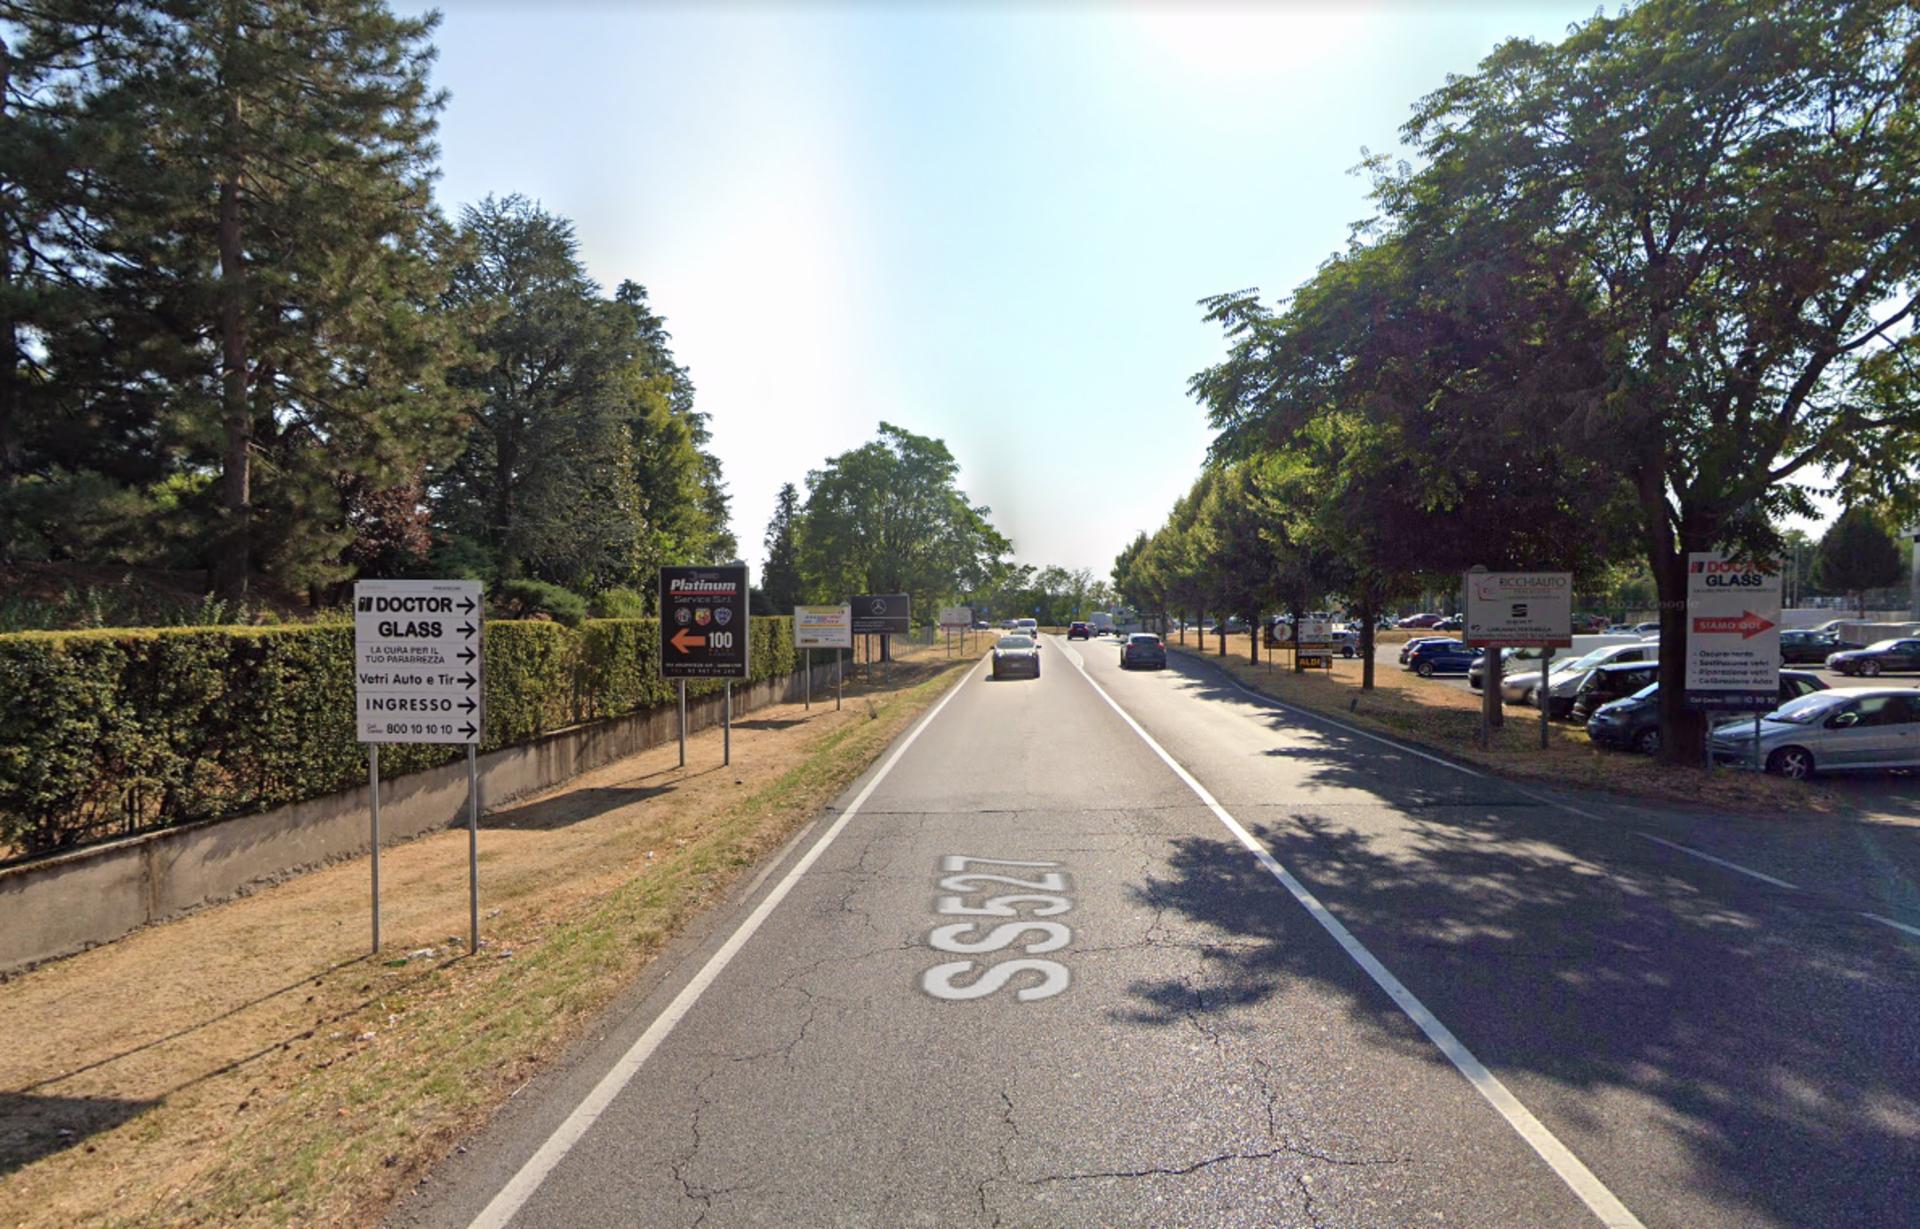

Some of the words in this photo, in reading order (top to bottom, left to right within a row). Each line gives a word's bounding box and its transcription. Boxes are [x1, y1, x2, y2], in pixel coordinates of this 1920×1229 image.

[1707, 560, 1783, 573] DOC
[670, 578, 736, 590] Platinum
[1500, 577, 1566, 587] RICCHIAUTO
[1706, 574, 1762, 587] GLASS
[376, 597, 452, 612] DOCTOR
[378, 621, 443, 637] GLASS
[1699, 622, 1736, 630] SIAMO
[709, 632, 732, 648] 100
[370, 646, 382, 654] LA
[384, 646, 408, 654] CURA
[411, 646, 429, 654] PER
[430, 646, 439, 654] IL
[365, 655, 384, 663] TUO
[387, 656, 445, 664] PARABREZZA
[359, 673, 388, 685] Vetri
[393, 674, 423, 685] Auto
[426, 676, 434, 685] e
[438, 674, 454, 685] Tir
[366, 698, 452, 711] INGRESSO
[387, 723, 408, 734] 800
[411, 724, 422, 734] 10
[426, 724, 438, 735] 10
[441, 724, 453, 735] 10
